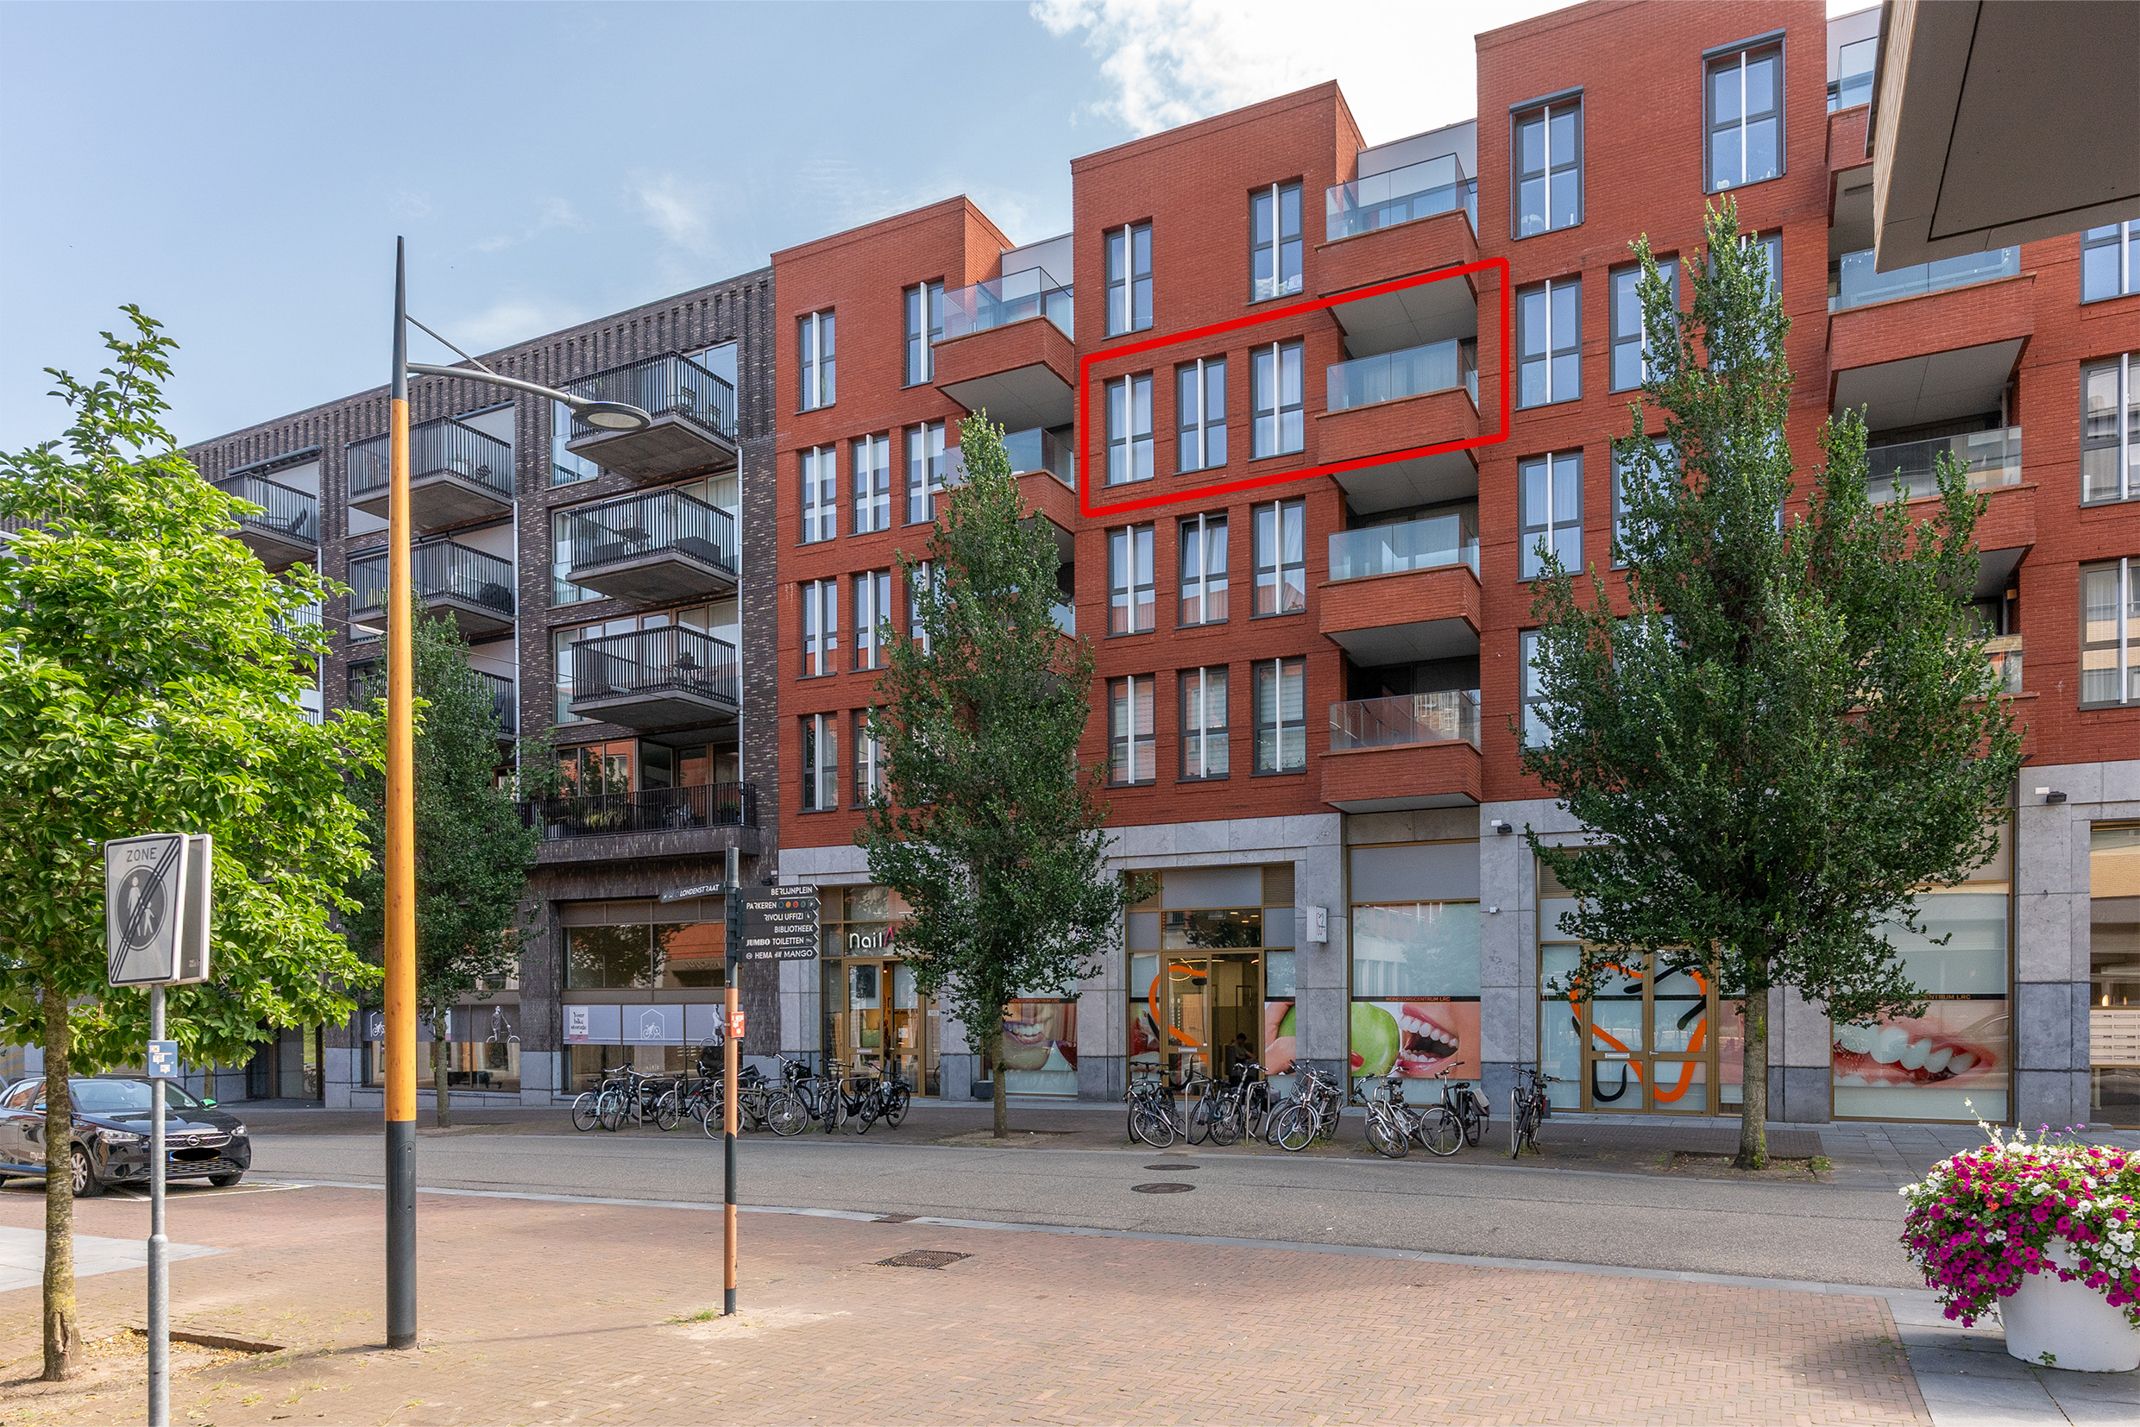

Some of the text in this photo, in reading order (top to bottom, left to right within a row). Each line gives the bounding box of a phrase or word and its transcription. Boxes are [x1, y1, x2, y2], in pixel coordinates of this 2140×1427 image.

[127, 847, 157, 862] ZONE
[680, 884, 720, 897] LONDENSTRAAT
[770, 886, 813, 896] BERLIJNPLEIN
[746, 901, 777, 910] PARKEREN
[764, 912, 804, 921] RIVOLI UFFIZI
[774, 924, 814, 933] BIBLIOTHEEK
[746, 936, 804, 947] JUMBO TOILETTEN
[754, 951, 773, 959] HEMA
[783, 950, 813, 958] MANGO
